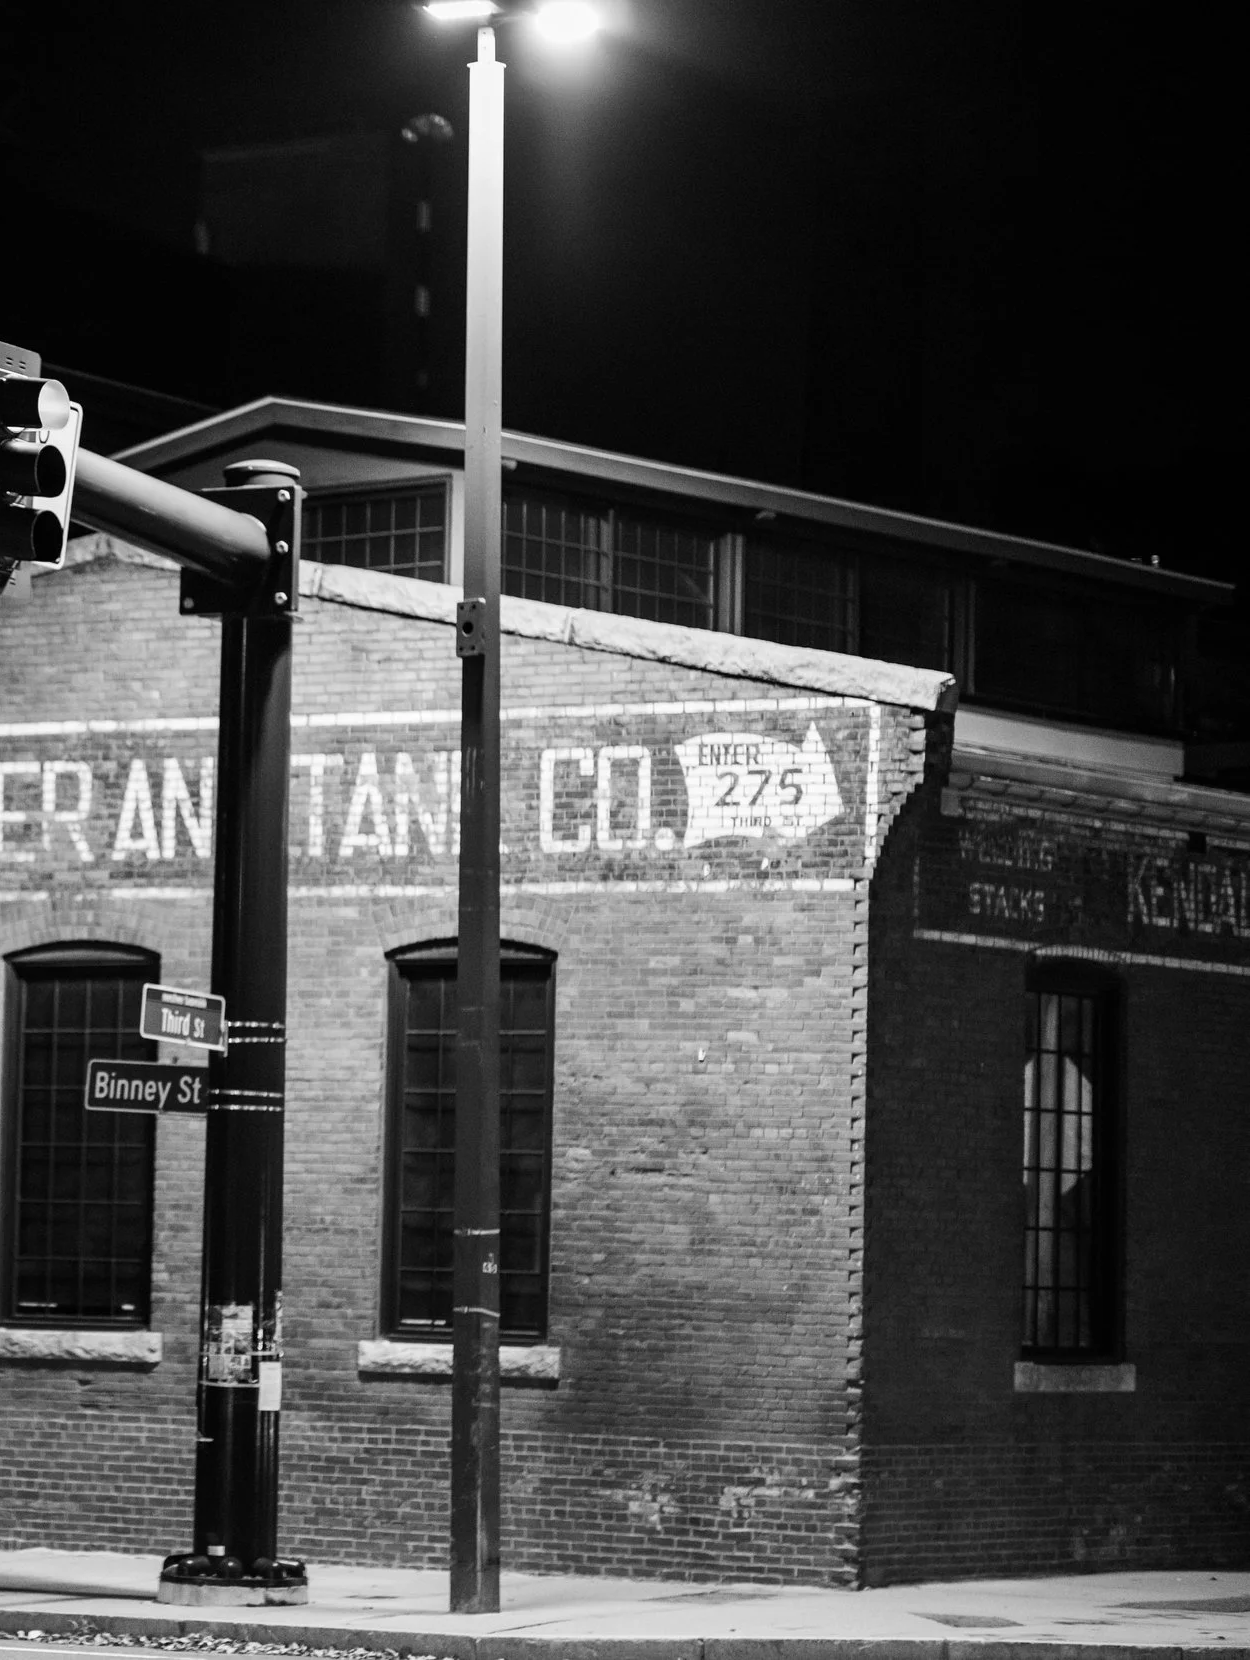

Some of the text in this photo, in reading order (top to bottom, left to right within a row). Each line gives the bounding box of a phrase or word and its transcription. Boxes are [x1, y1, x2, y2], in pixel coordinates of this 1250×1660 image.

[698, 743, 760, 766] ENTER
[112, 756, 214, 860] AN
[539, 744, 676, 852] CO.
[714, 768, 803, 806] 275
[730, 815, 772, 828] THIRD
[161, 1007, 206, 1039] Third St
[94, 1070, 202, 1110] Binney St
